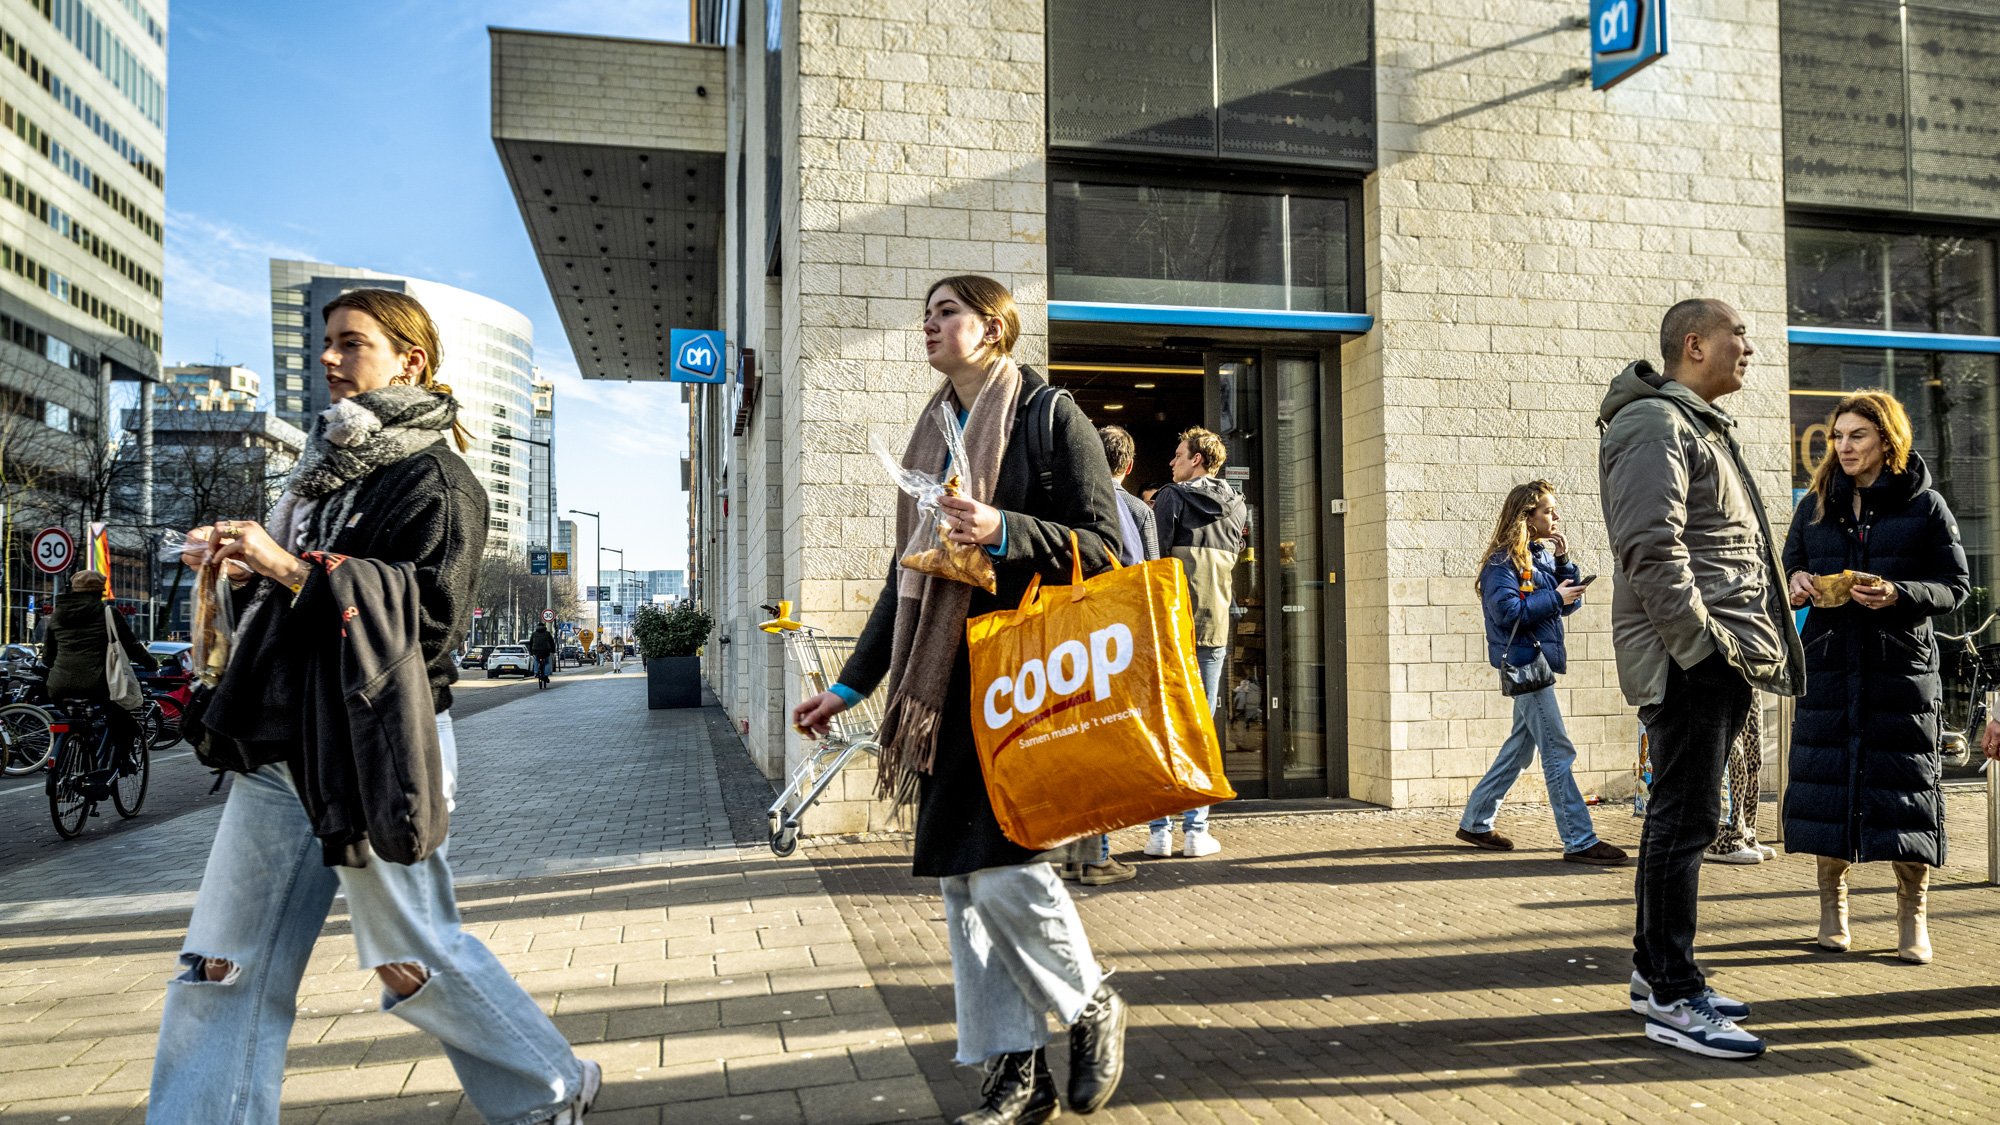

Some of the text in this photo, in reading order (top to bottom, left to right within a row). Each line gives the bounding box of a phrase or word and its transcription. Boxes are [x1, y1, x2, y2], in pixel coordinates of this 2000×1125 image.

[40, 542, 65, 558] 30
[984, 623, 1133, 730] coop
[1019, 733, 1050, 749] Samen
[1051, 724, 1079, 739] maak
[1080, 721, 1090, 733] je
